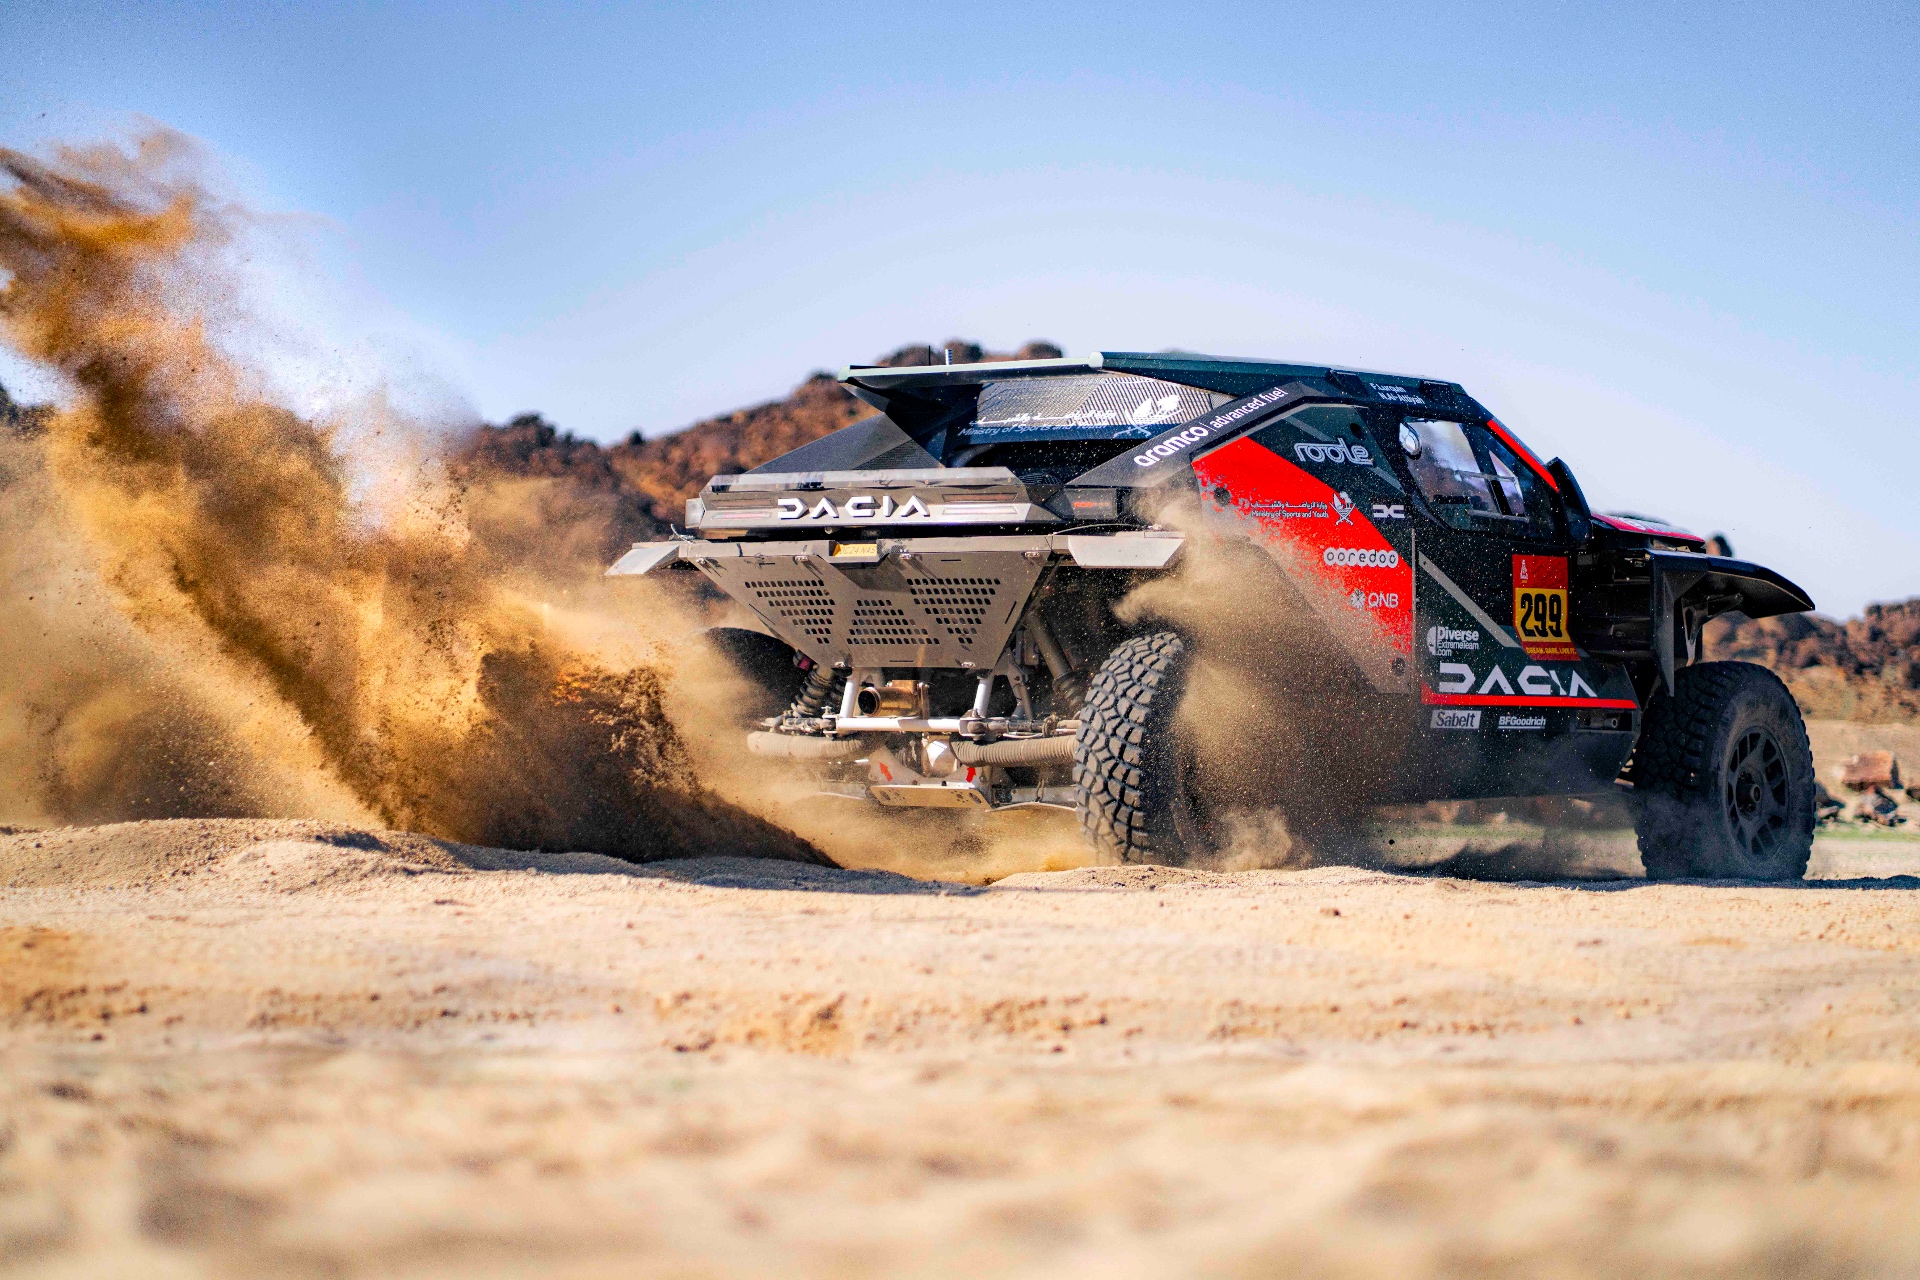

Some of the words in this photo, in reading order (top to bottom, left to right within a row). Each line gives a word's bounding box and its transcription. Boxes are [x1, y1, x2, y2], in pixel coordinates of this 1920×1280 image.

[957, 427, 999, 437] Ministry
[1002, 424, 1015, 434] of
[1014, 423, 1051, 435] Sports
[1133, 426, 1209, 467] aramco
[1209, 397, 1267, 428] advanced
[1261, 386, 1288, 403] fuel
[1293, 437, 1374, 466] roole
[777, 494, 930, 519] DACIA
[1302, 510, 1312, 518] and
[1325, 549, 1397, 567] ooredoo
[1368, 592, 1399, 609] QNB
[1520, 592, 1563, 637] 299
[1437, 626, 1480, 641] Diverse
[1437, 640, 1480, 650] ExtremeTeam
[1437, 649, 1452, 657] .com
[1439, 662, 1598, 698] DACIA
[1435, 711, 1476, 728] Sabelt
[1498, 715, 1546, 727] BFGoodrich
